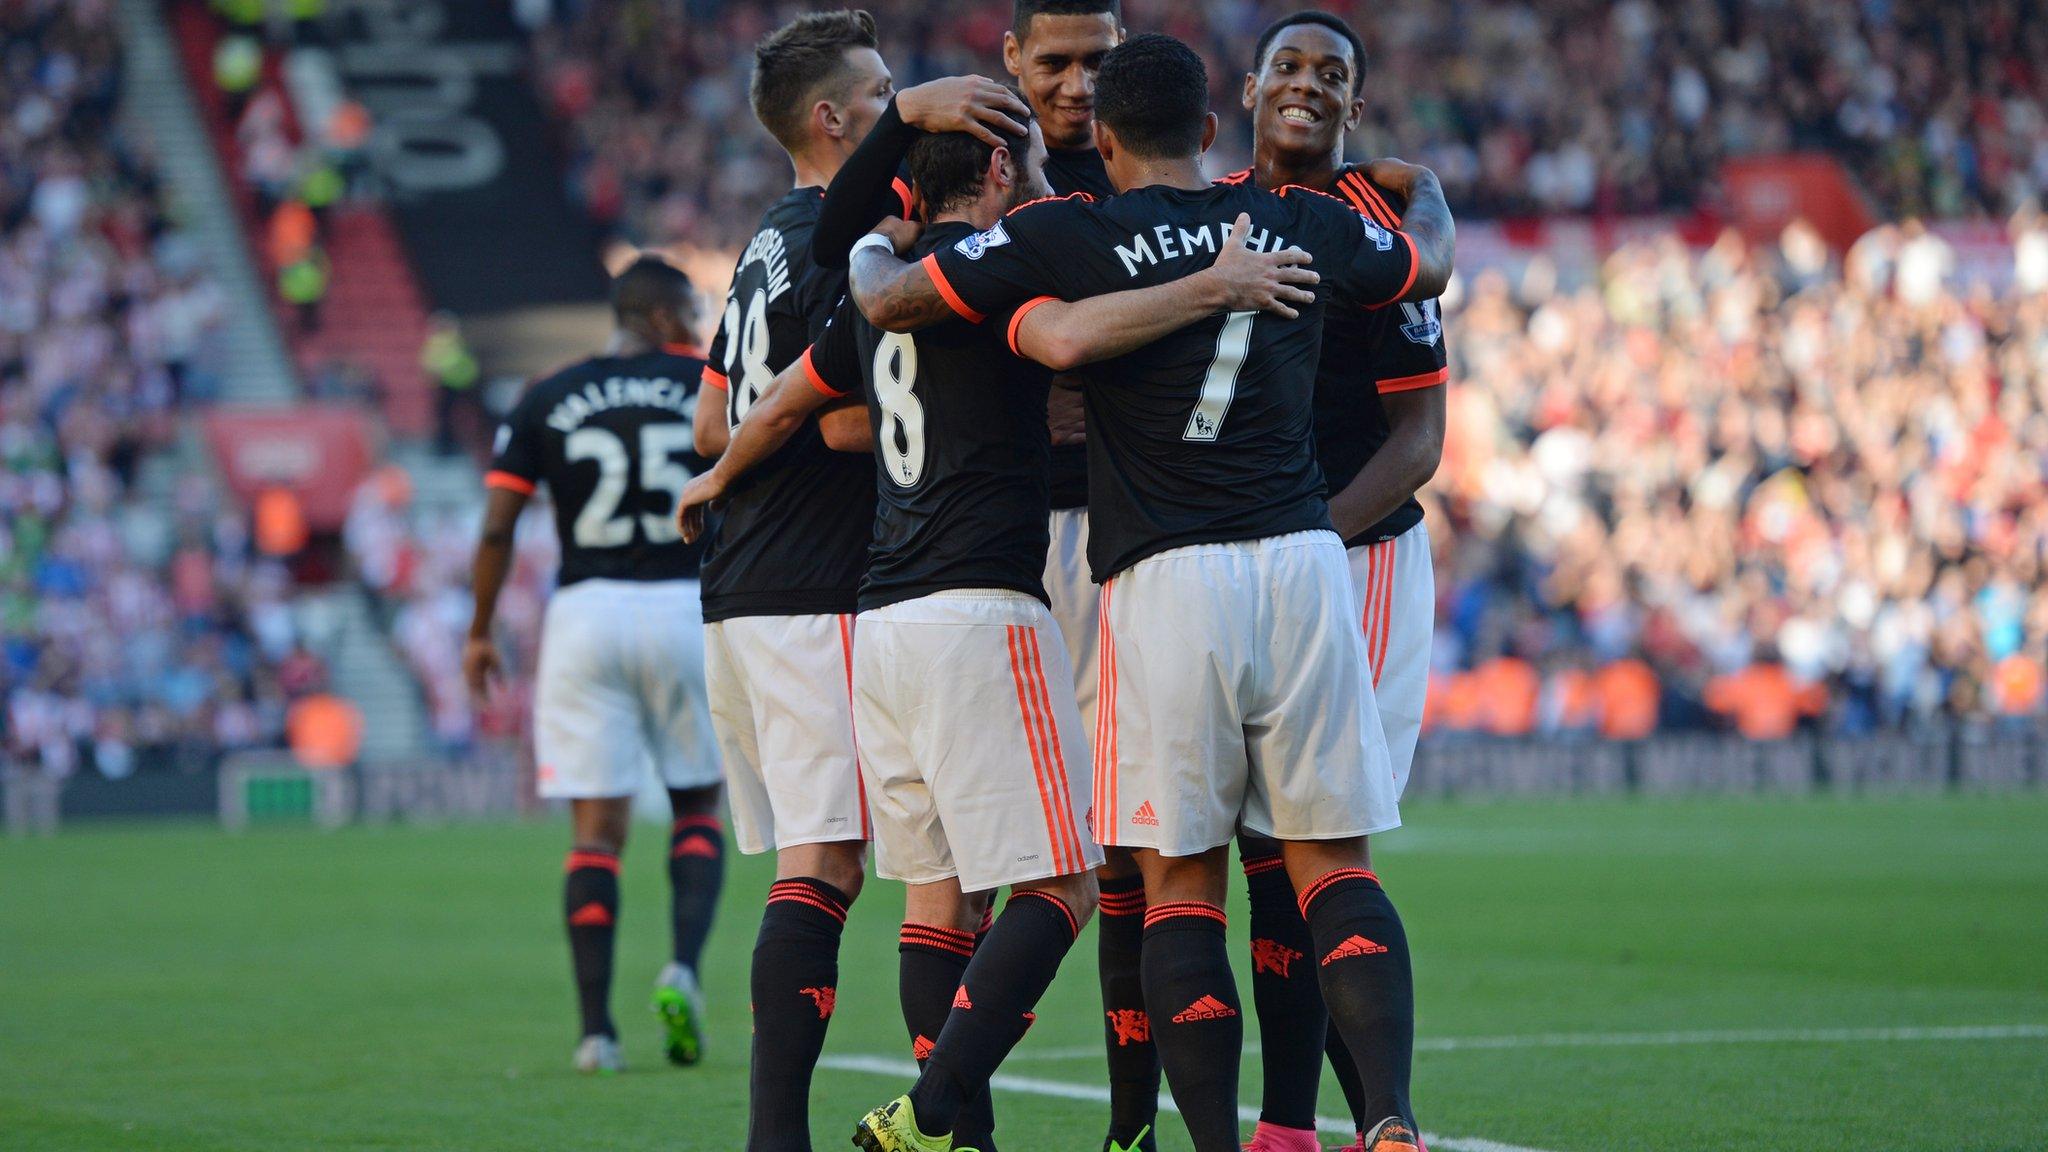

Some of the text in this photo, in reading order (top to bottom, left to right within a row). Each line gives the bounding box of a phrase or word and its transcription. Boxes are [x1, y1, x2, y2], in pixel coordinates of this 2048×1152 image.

[873, 331, 926, 488] 8
[565, 422, 696, 548] 25
[1320, 945, 1388, 967] adidas
[1172, 1008, 1237, 1024] adidas
